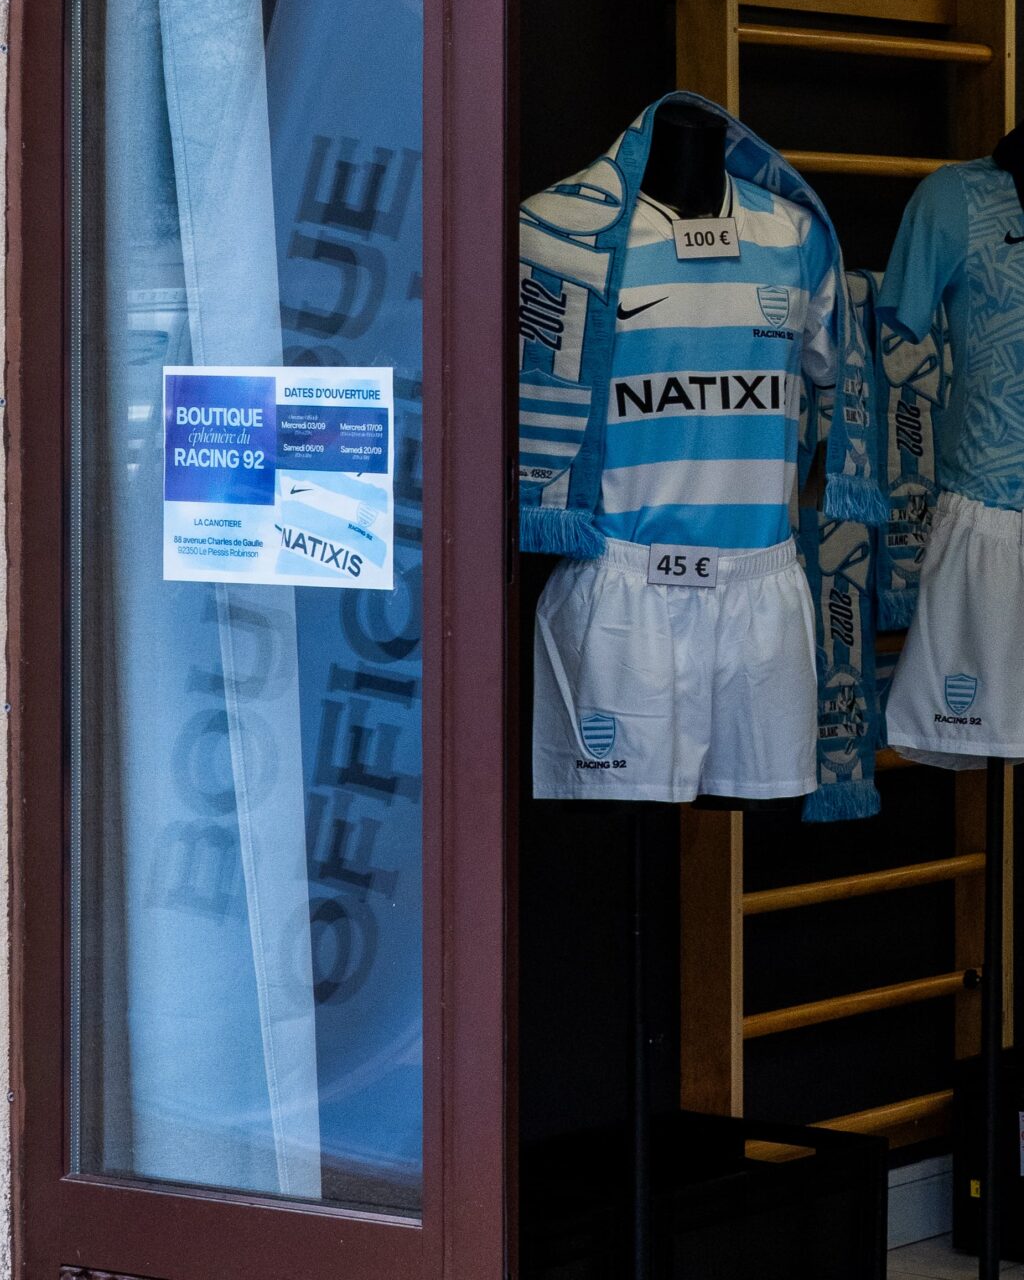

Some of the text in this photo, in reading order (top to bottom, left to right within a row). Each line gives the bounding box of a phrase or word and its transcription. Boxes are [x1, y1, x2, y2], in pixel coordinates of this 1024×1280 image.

[684, 230, 731, 247] 100 €
[519, 277, 568, 351] 2012
[752, 328, 785, 339] RACING
[284, 387, 381, 400] DATES D'OUVERTURE
[615, 375, 786, 417] NATIXI
[176, 406, 263, 427] BOUTIQUE
[281, 421, 307, 430] Mercredi
[188, 428, 251, 446] éphémère du
[895, 400, 924, 458] 2022
[174, 448, 265, 470] RACING 92
[194, 518, 242, 528] LA CANOTIERE
[174, 536, 183, 544] 88
[207, 537, 233, 547] Charles
[234, 538, 242, 546] de
[242, 539, 263, 548] Gaulle
[281, 527, 363, 578] NATIXIS
[656, 554, 710, 578] 45 €
[829, 588, 855, 647] 2022
[934, 713, 982, 725] RACING 92
[576, 759, 627, 769] RACING 92
